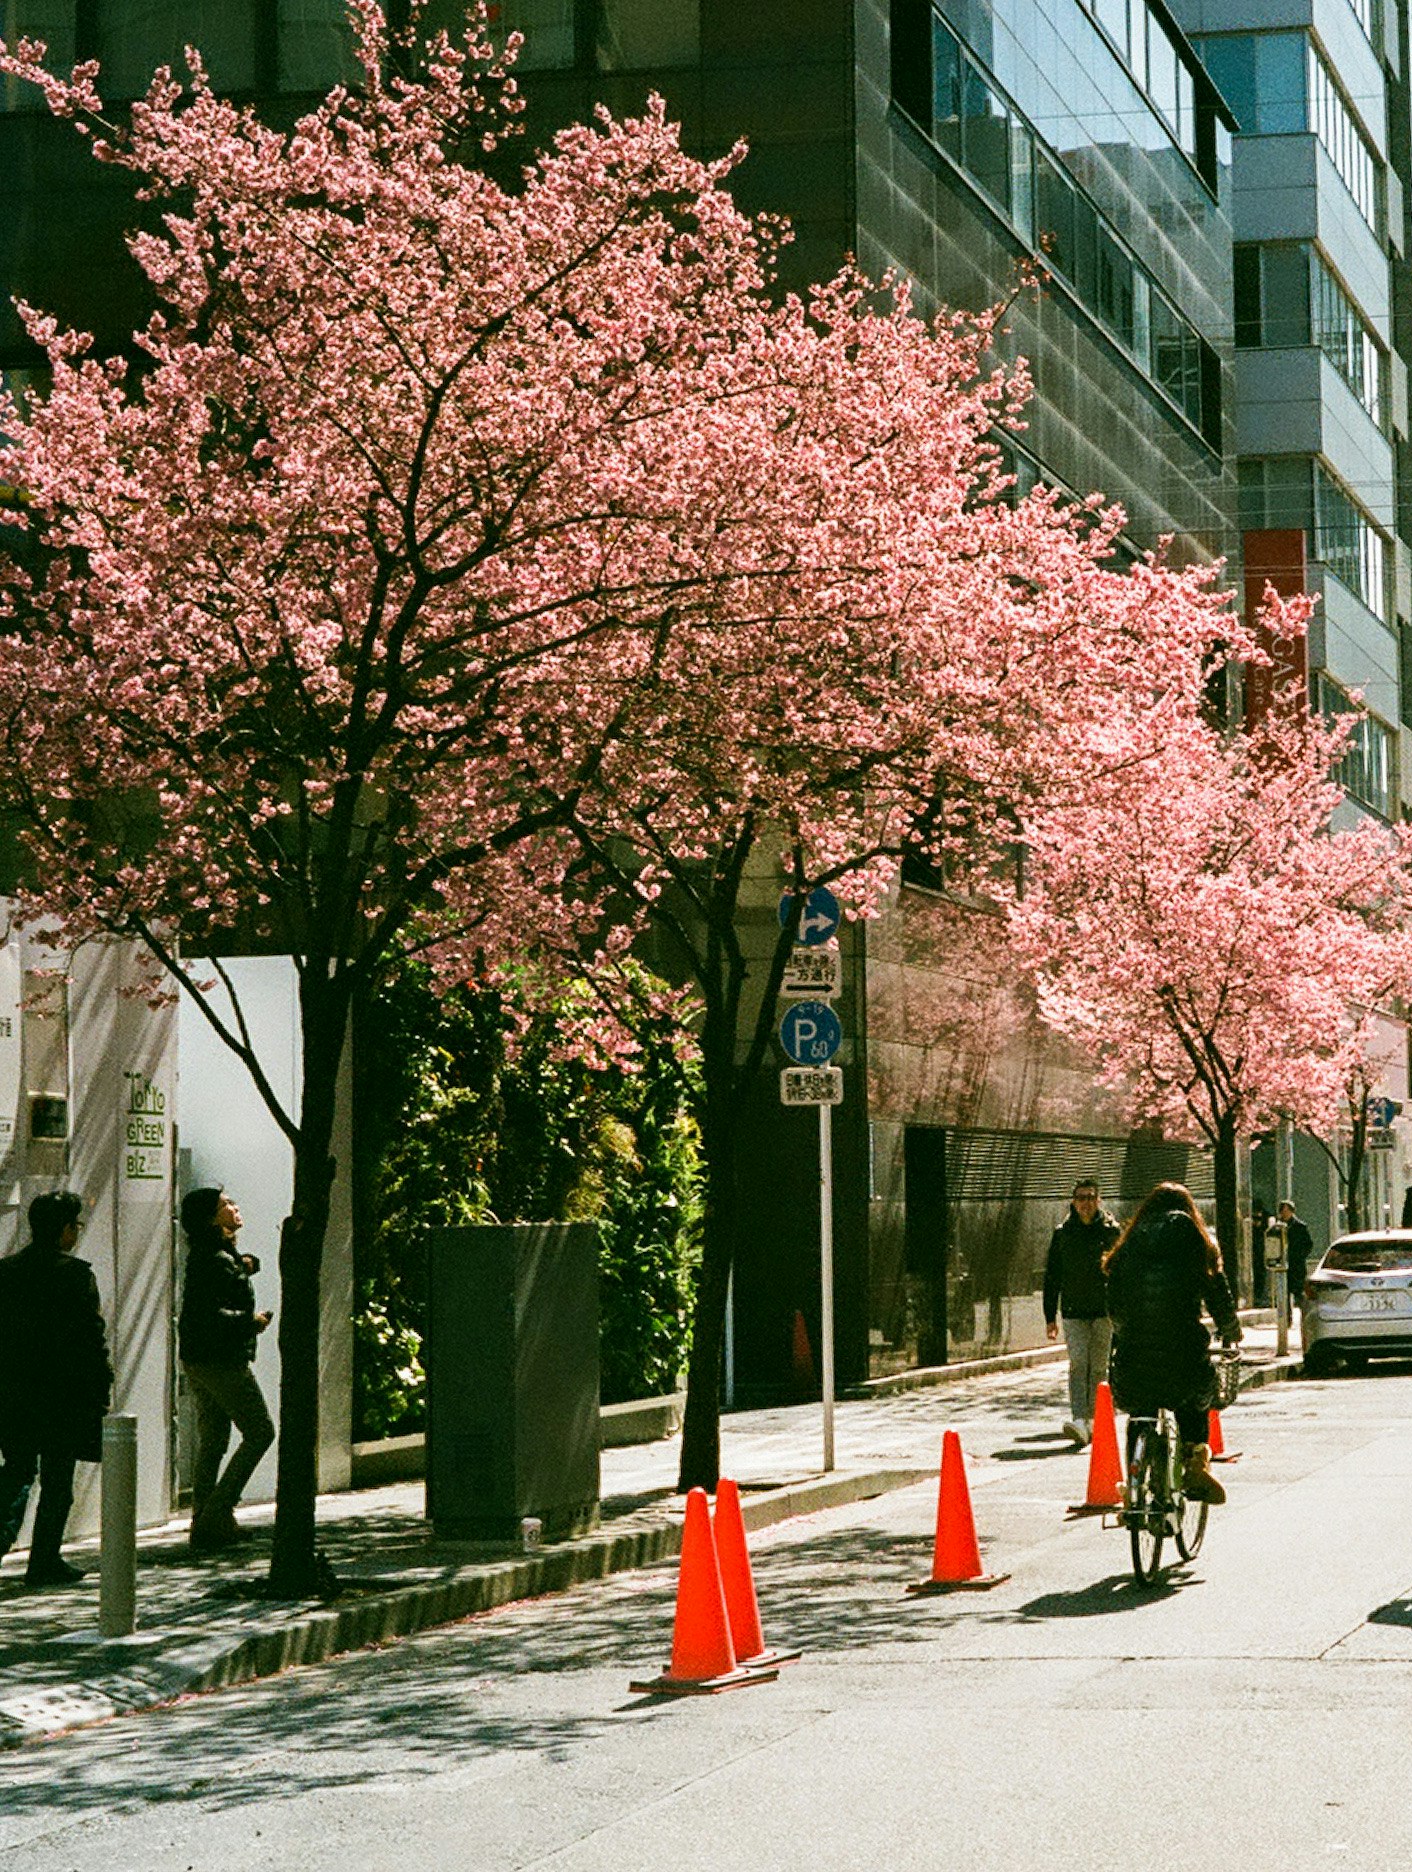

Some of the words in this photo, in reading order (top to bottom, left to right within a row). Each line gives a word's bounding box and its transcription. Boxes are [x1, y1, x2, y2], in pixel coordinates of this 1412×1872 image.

[784, 968, 836, 982] 一方通行
[795, 1019, 817, 1058] P
[124, 1072, 165, 1110] TOKYO
[127, 1117, 165, 1140] GREEN
